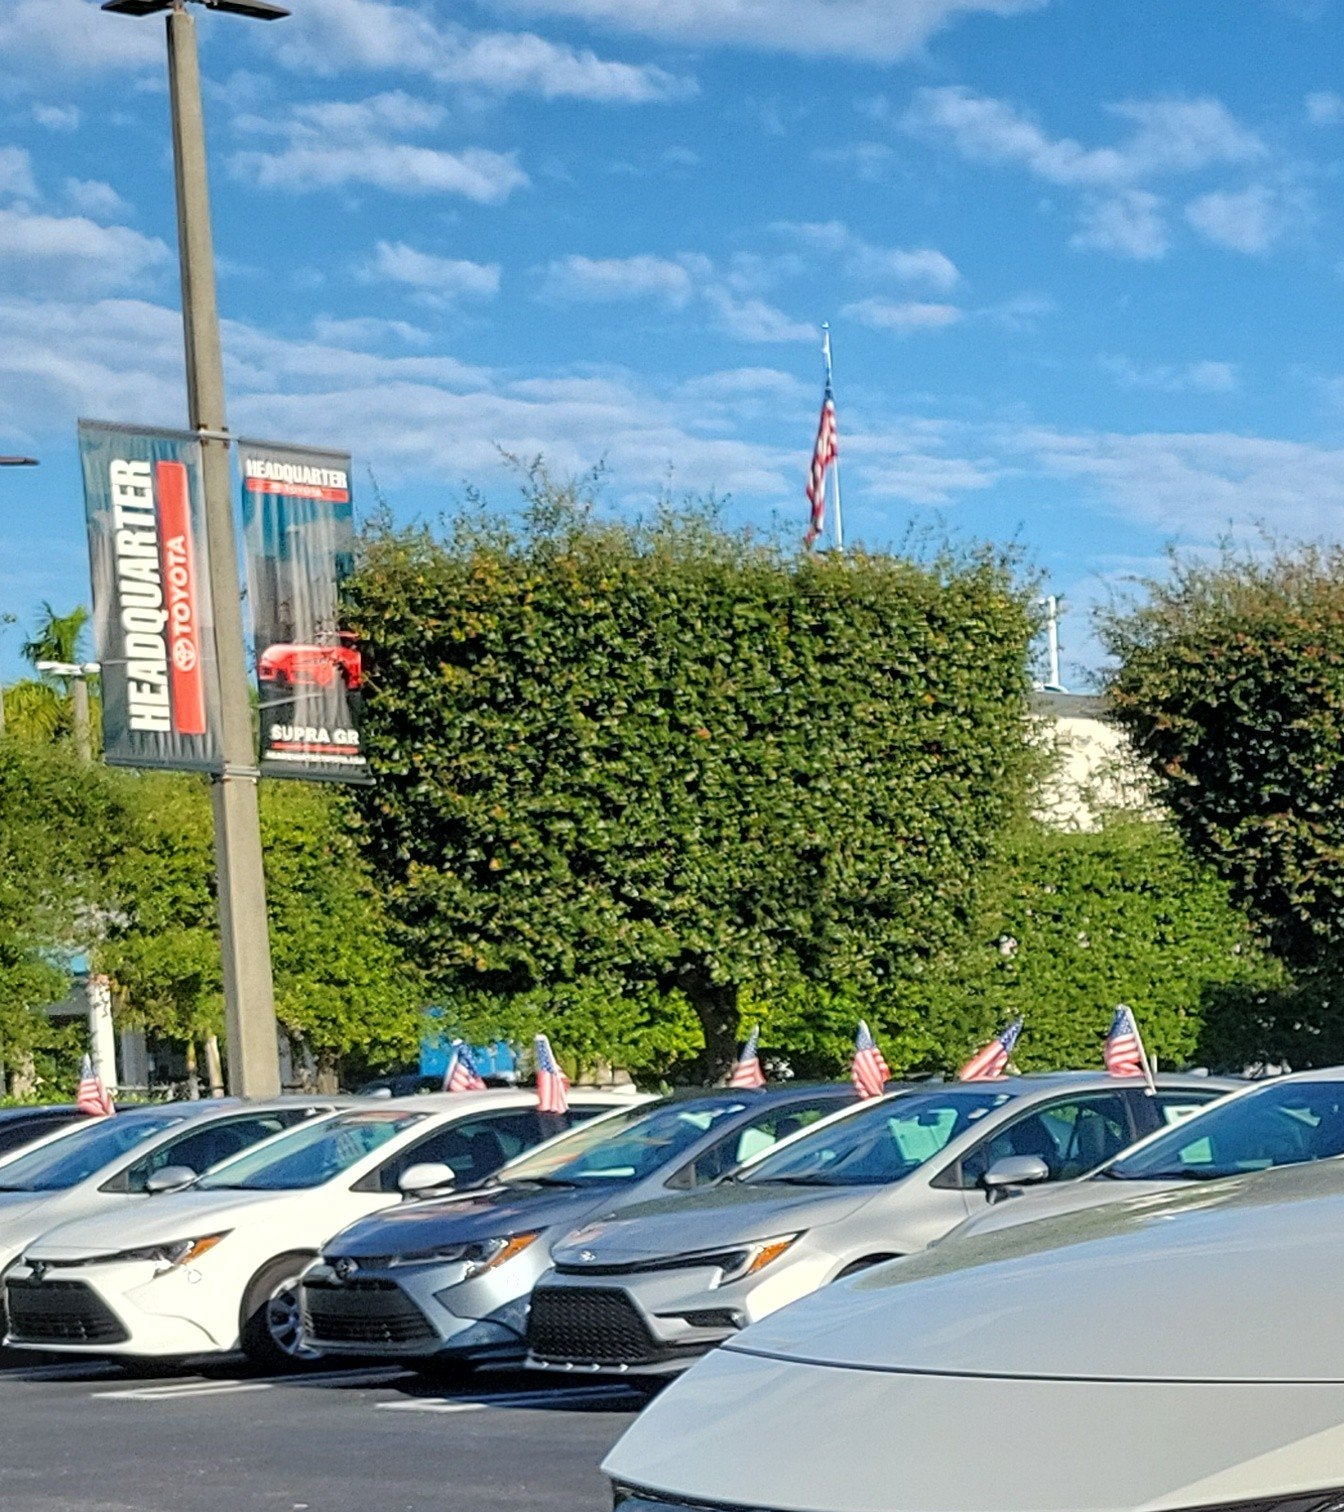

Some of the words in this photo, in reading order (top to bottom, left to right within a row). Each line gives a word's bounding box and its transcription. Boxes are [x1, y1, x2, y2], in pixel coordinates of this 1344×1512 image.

[246, 459, 348, 489] HEADQUARTER
[110, 459, 171, 732] HEADQUARTER
[166, 535, 193, 637] TOYOTA
[271, 724, 330, 743] SUPRA
[333, 728, 360, 745] GR
